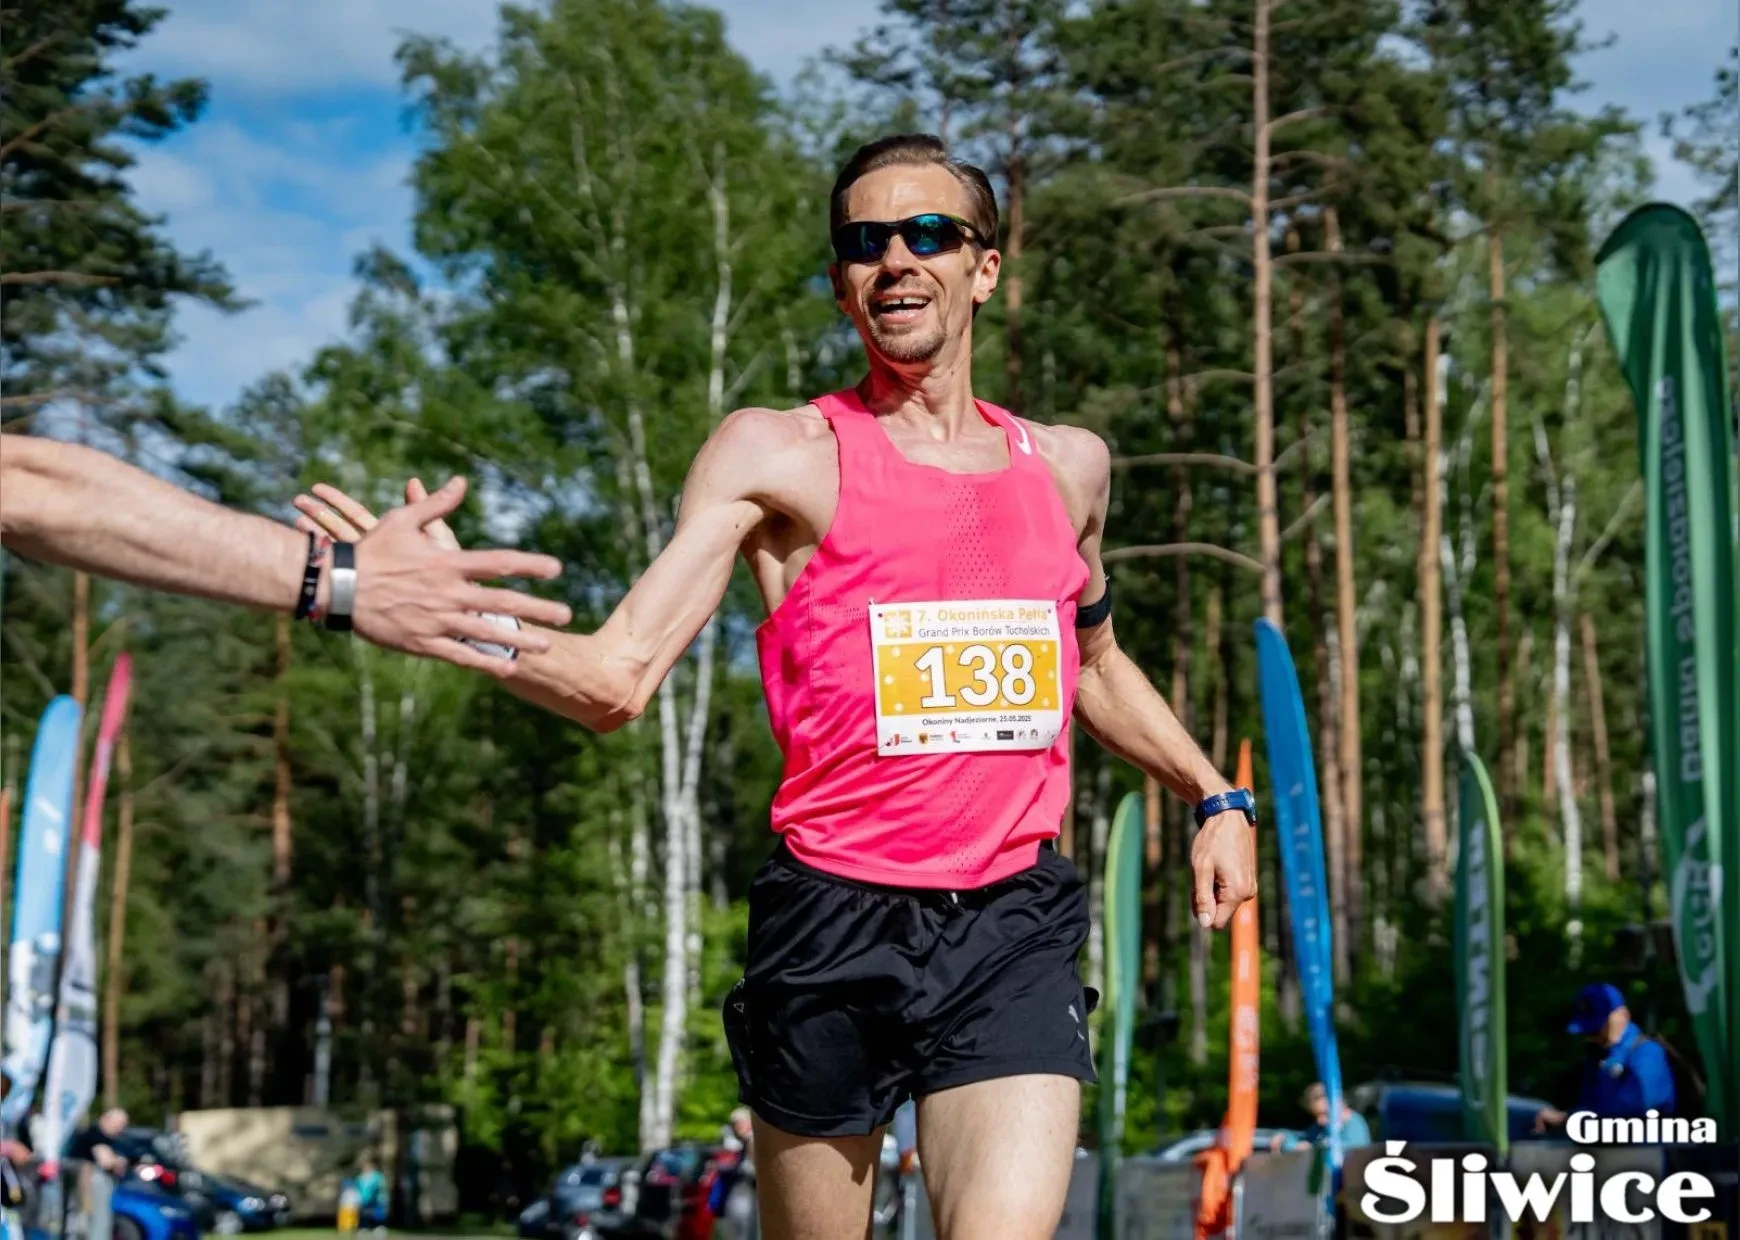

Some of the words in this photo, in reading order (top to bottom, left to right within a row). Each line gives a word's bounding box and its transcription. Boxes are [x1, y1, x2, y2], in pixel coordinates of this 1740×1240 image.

[917, 610, 931, 622] 7.
[918, 628, 949, 639] Grand
[951, 626, 969, 637] Prix
[972, 624, 1002, 636] Borów
[914, 643, 1036, 709] 138
